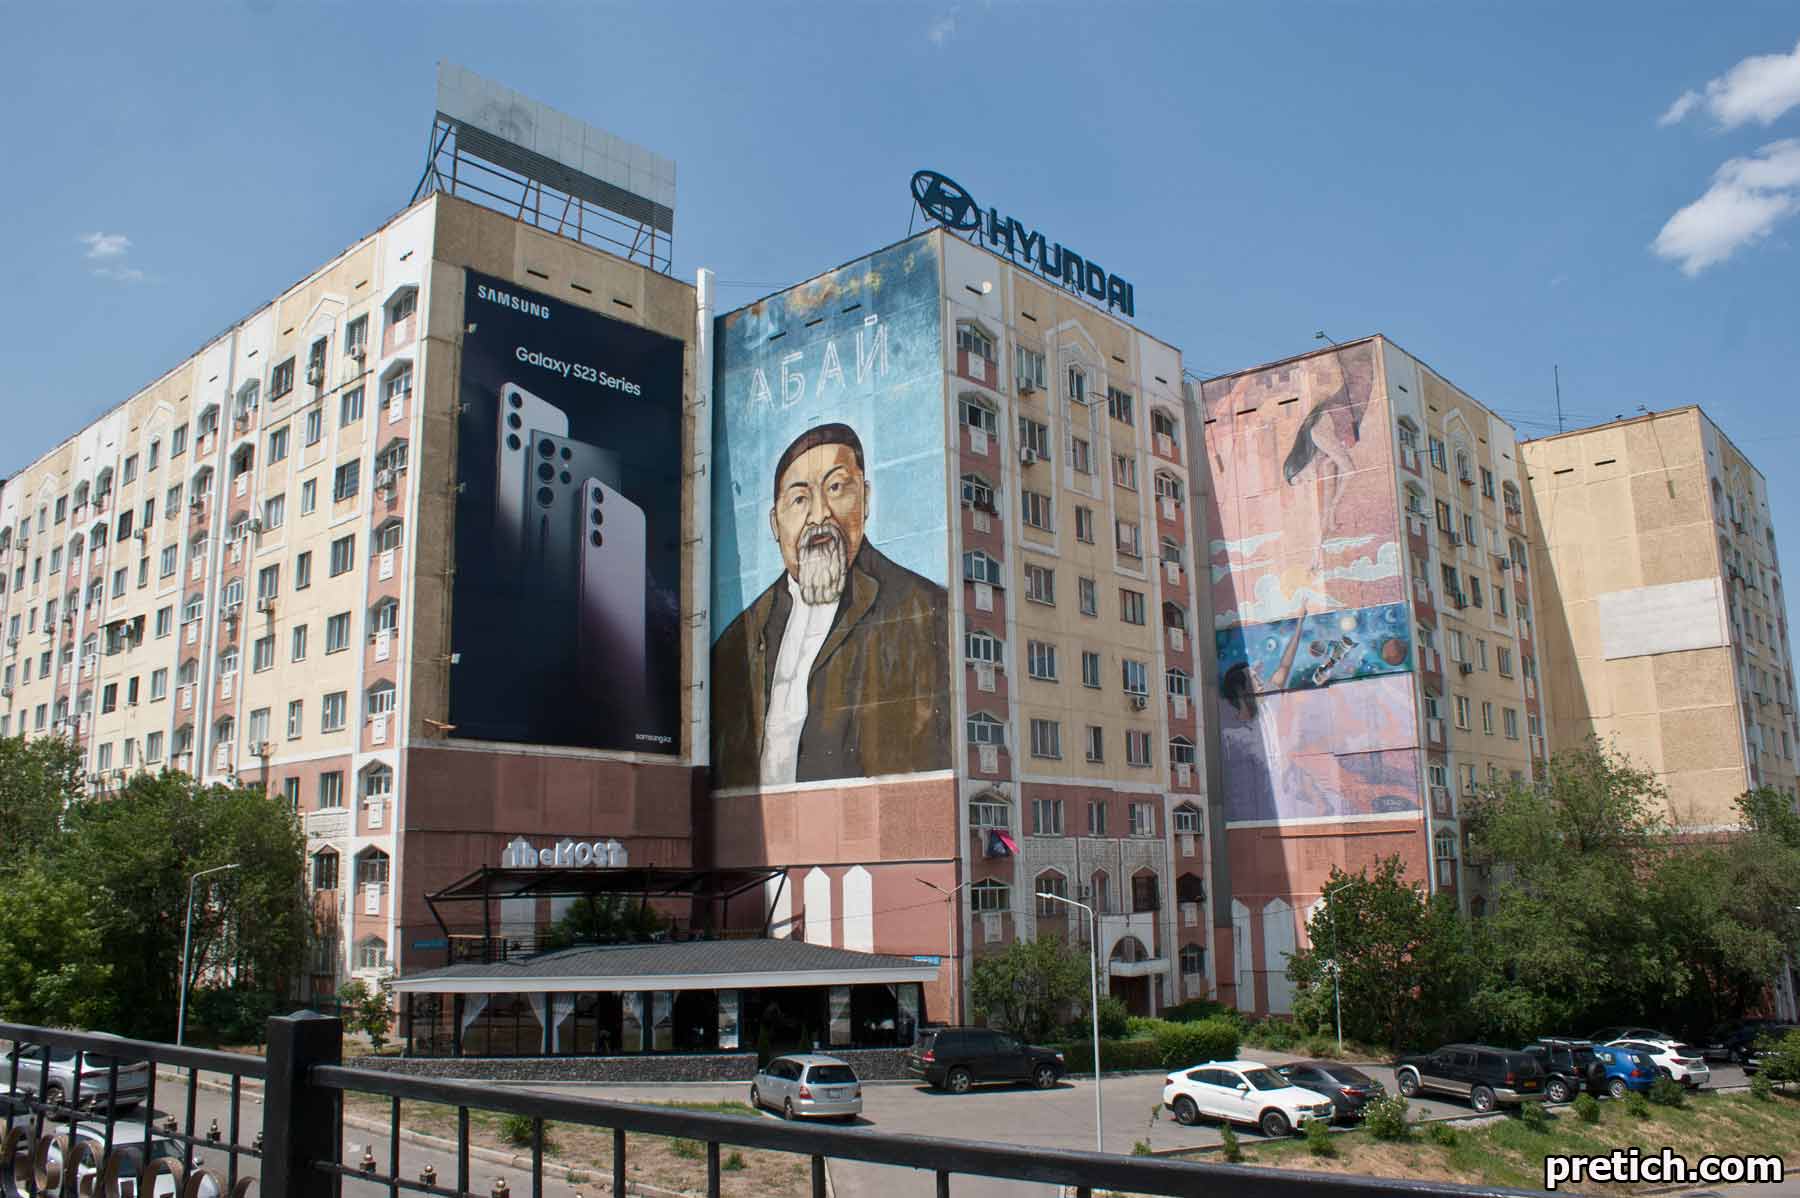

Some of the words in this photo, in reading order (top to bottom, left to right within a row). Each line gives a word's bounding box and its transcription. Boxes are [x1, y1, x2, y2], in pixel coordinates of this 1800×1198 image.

[989, 207, 1135, 318] HYUNDAI
[478, 284, 550, 319] SAMSUNG
[516, 346, 570, 377] Galaxy
[573, 364, 597, 383] S23
[599, 371, 641, 396] Series
[747, 314, 889, 413] АБАЙ
